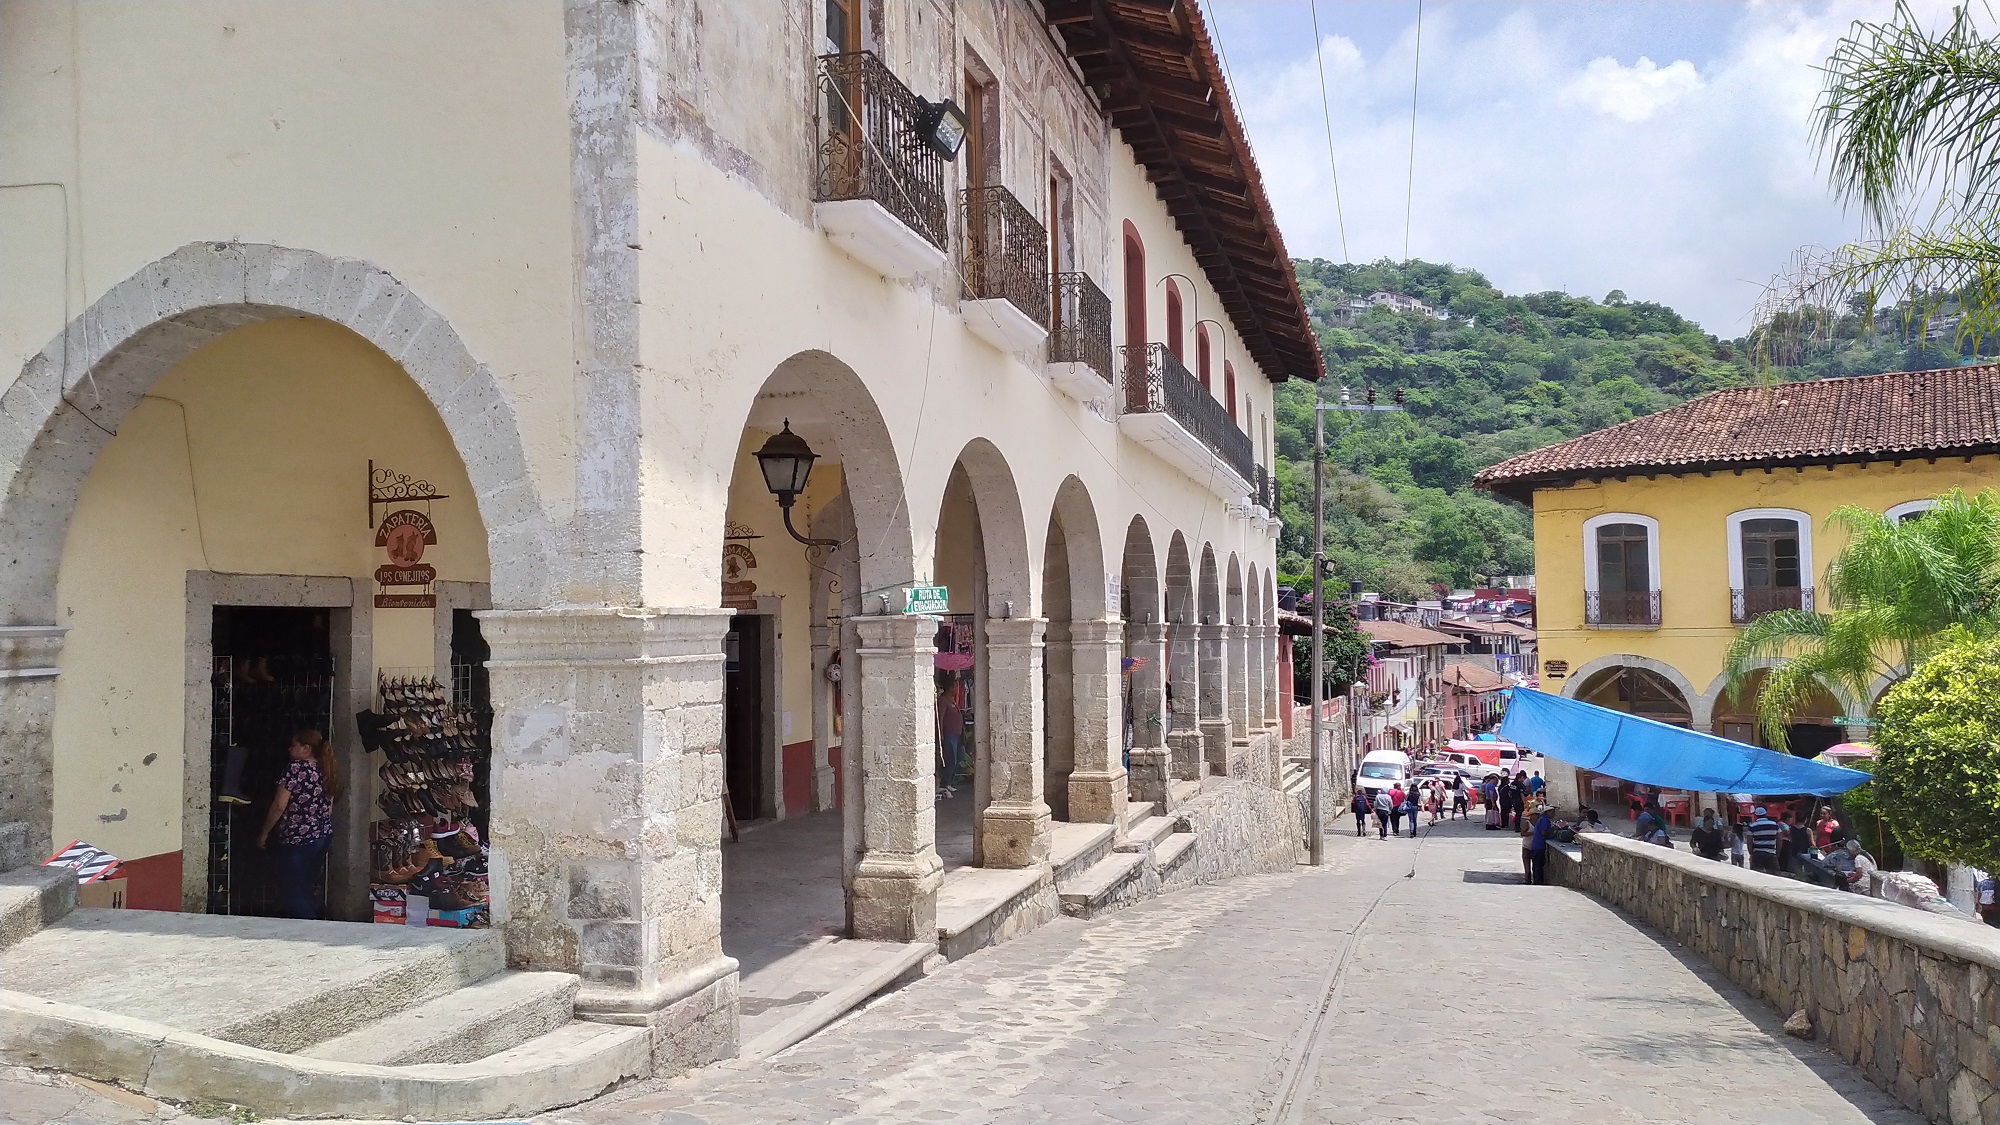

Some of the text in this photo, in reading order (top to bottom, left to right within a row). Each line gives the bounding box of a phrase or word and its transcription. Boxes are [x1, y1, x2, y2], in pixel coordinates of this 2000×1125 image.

[379, 513, 431, 539] ZAPATERIA
[723, 546, 754, 564] RMACIA
[919, 590, 941, 600] RUTA DE
[379, 597, 430, 607] Bienvenidos
[914, 600, 946, 611] EVACUACION
